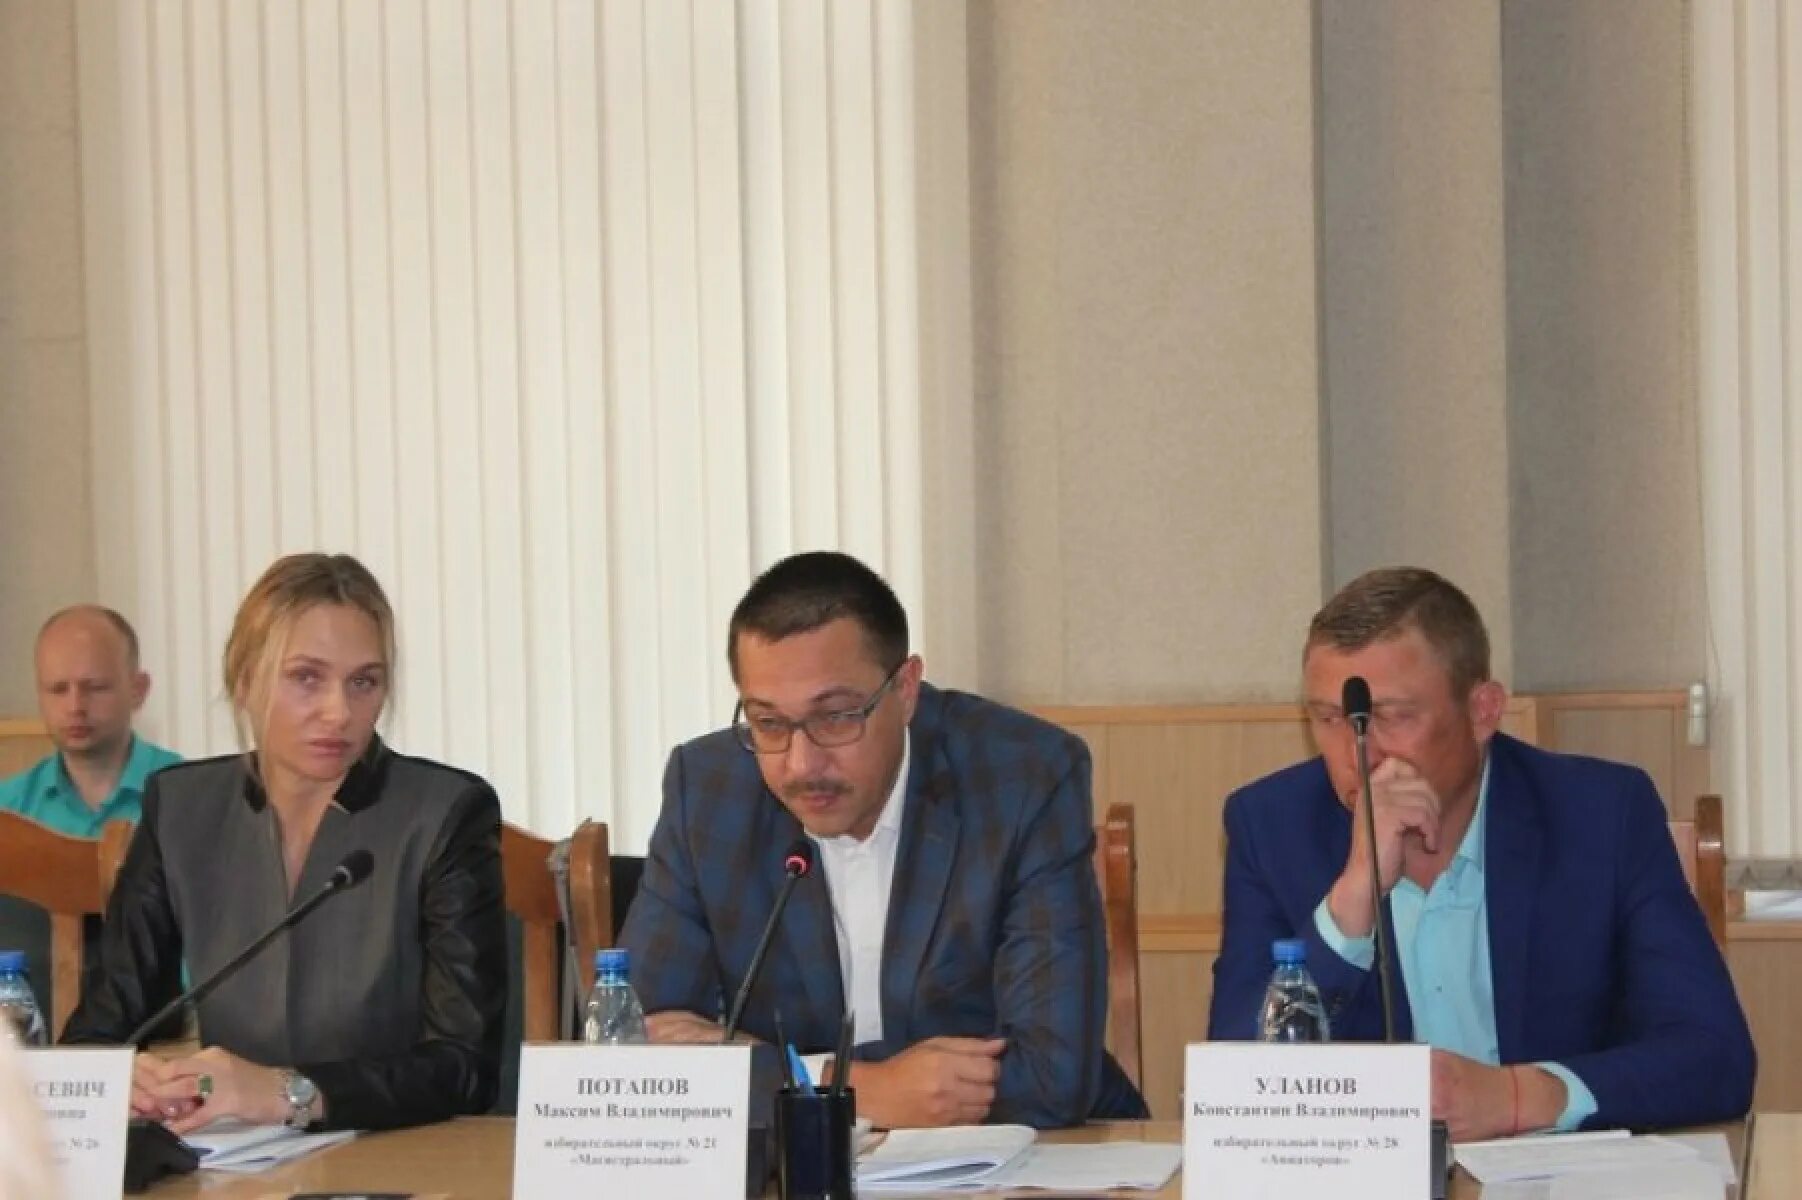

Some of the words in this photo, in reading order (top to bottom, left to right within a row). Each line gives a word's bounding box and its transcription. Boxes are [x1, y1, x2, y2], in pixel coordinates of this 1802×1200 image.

[34, 1080, 106, 1097] СЕВИЧ
[577, 1077, 689, 1095] ПОТАПОВ
[1255, 1077, 1358, 1095] УЛАНОВ
[534, 1103, 601, 1119] Максим
[606, 1103, 733, 1122] Владимирович
[1193, 1102, 1292, 1117] Константин
[1295, 1102, 1421, 1121] Владимирович
